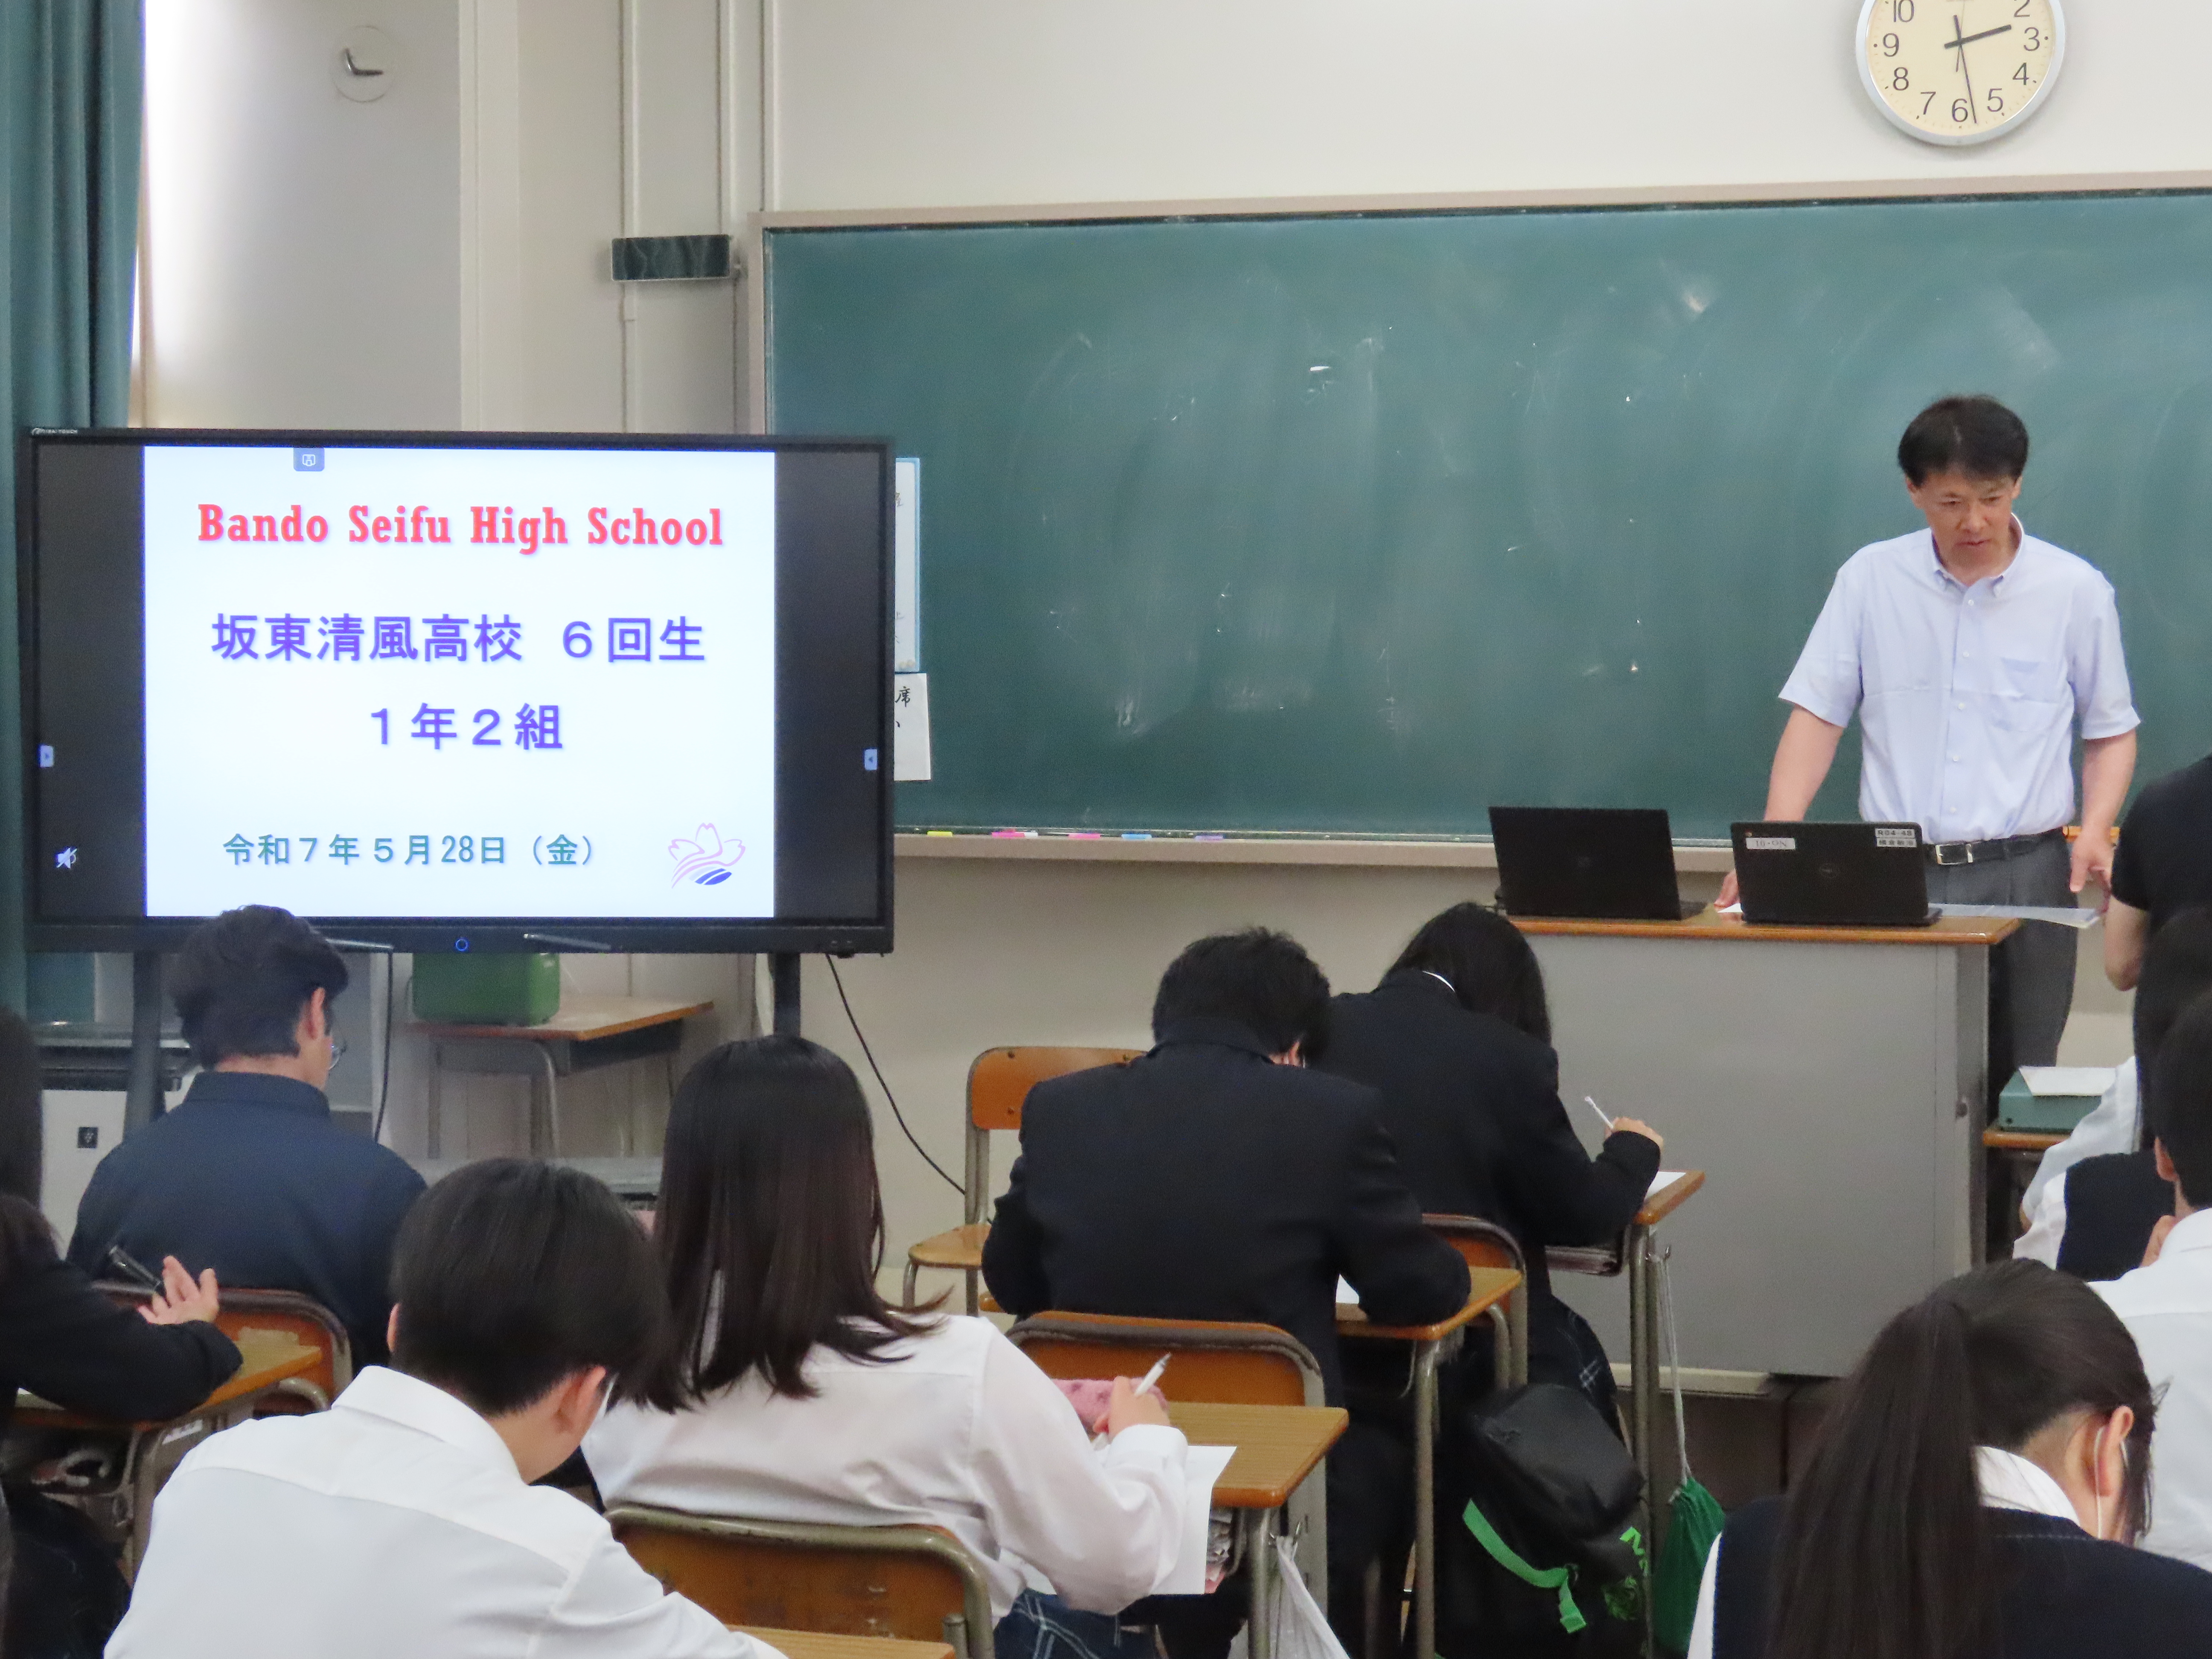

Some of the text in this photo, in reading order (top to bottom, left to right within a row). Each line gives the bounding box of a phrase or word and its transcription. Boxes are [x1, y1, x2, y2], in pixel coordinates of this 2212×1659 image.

[1894, 0, 1914, 22] 10
[2014, 0, 2030, 17] 2
[1883, 33, 1899, 57] 9
[2024, 27, 2040, 51] 3
[1893, 67, 1909, 90] 8
[2012, 62, 2029, 85] 4
[1920, 91, 1936, 115] 7
[1952, 99, 1968, 122] 6
[1987, 88, 2003, 112] 5
[198, 504, 722, 555] Bando Seifu High School
[212, 613, 705, 663] 坂東清風高校 6回生
[371, 703, 562, 750] 1年2組
